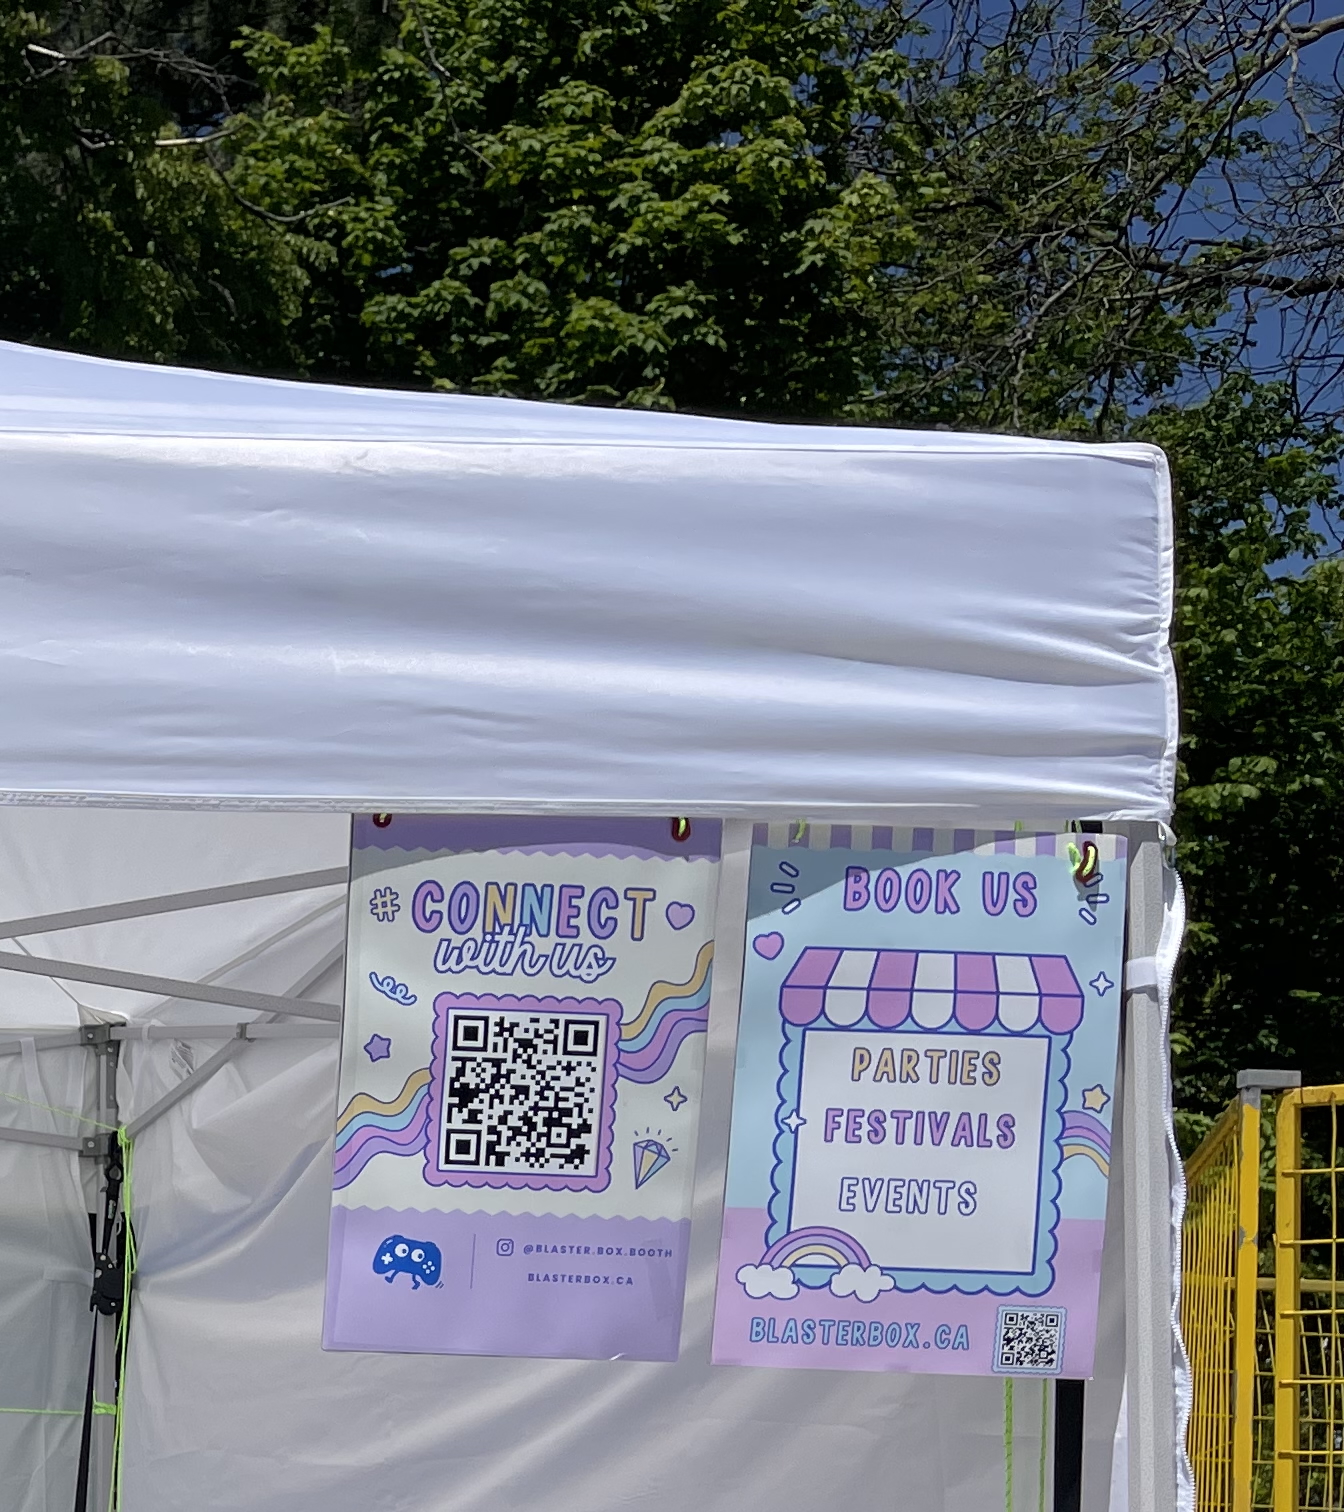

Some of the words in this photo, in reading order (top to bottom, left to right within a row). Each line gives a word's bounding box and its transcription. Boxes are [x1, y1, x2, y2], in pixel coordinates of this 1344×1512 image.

[412, 880, 656, 941] CONNECT
[843, 866, 961, 915] BOOK
[982, 871, 1038, 918] US
[432, 924, 550, 978] with
[550, 941, 617, 984] us
[851, 1047, 1002, 1088] PARTIES
[824, 1107, 1017, 1149] FESTIVALS
[838, 1176, 978, 1217] EVENTS
[523, 1243, 673, 1259] @BLASTER.BOX.BOOTH
[527, 1272, 634, 1287] BLASTERBOX.CA
[749, 1316, 971, 1351] BLASTERBOX.CA
